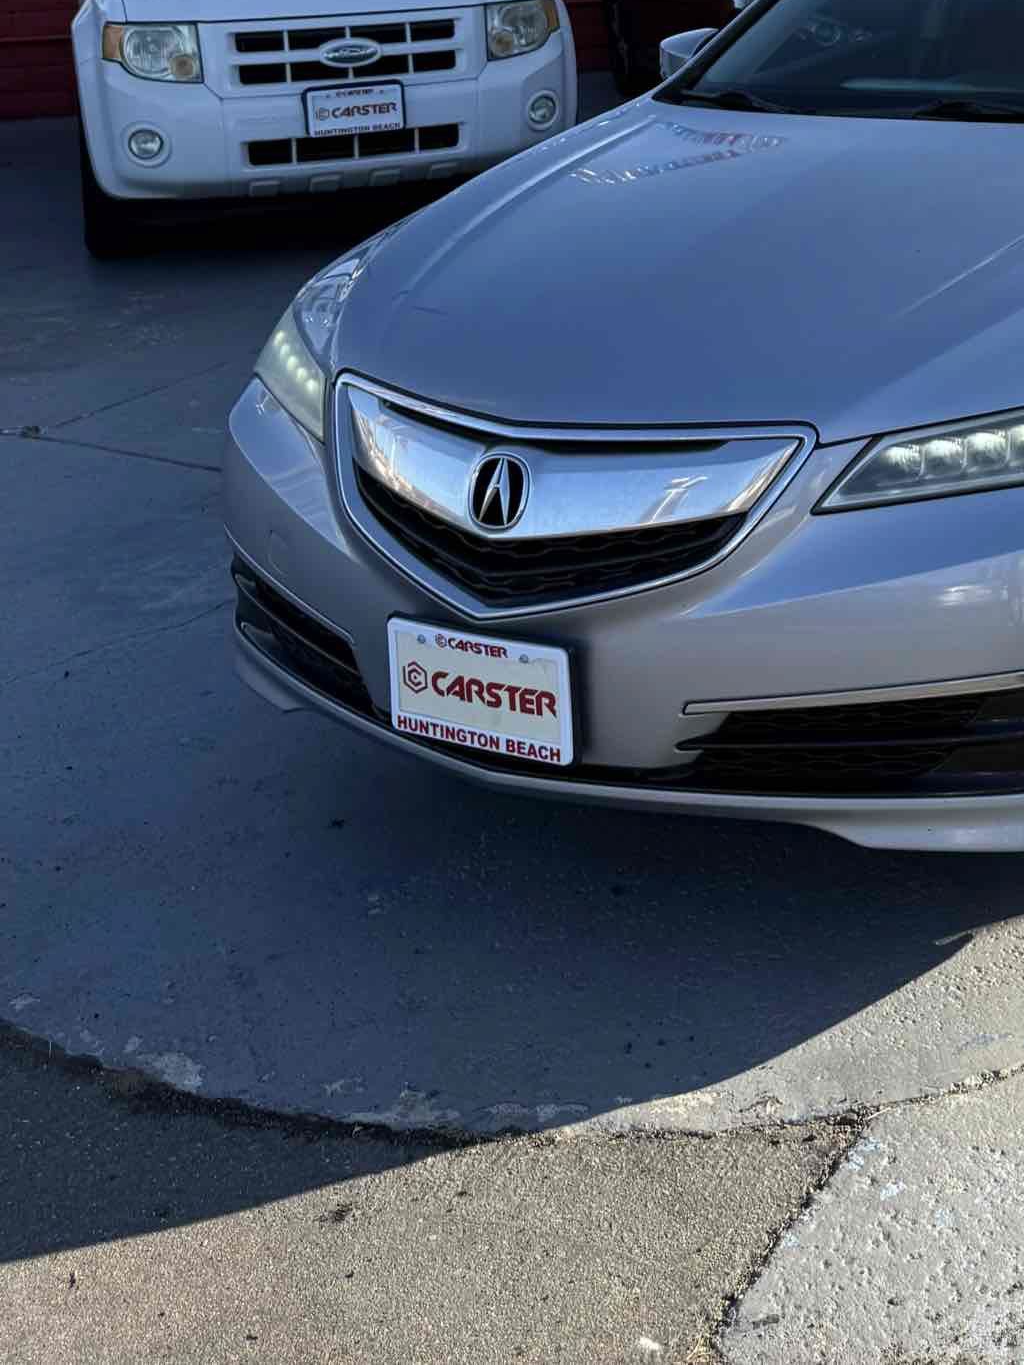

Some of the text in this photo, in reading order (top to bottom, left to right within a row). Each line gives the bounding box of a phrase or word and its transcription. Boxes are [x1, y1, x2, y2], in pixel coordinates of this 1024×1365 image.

[331, 101, 398, 119] CARSTER
[447, 637, 509, 659] CARSTER
[431, 670, 558, 719] CARSTER
[396, 714, 562, 763] HUNTINGTON BEACH
